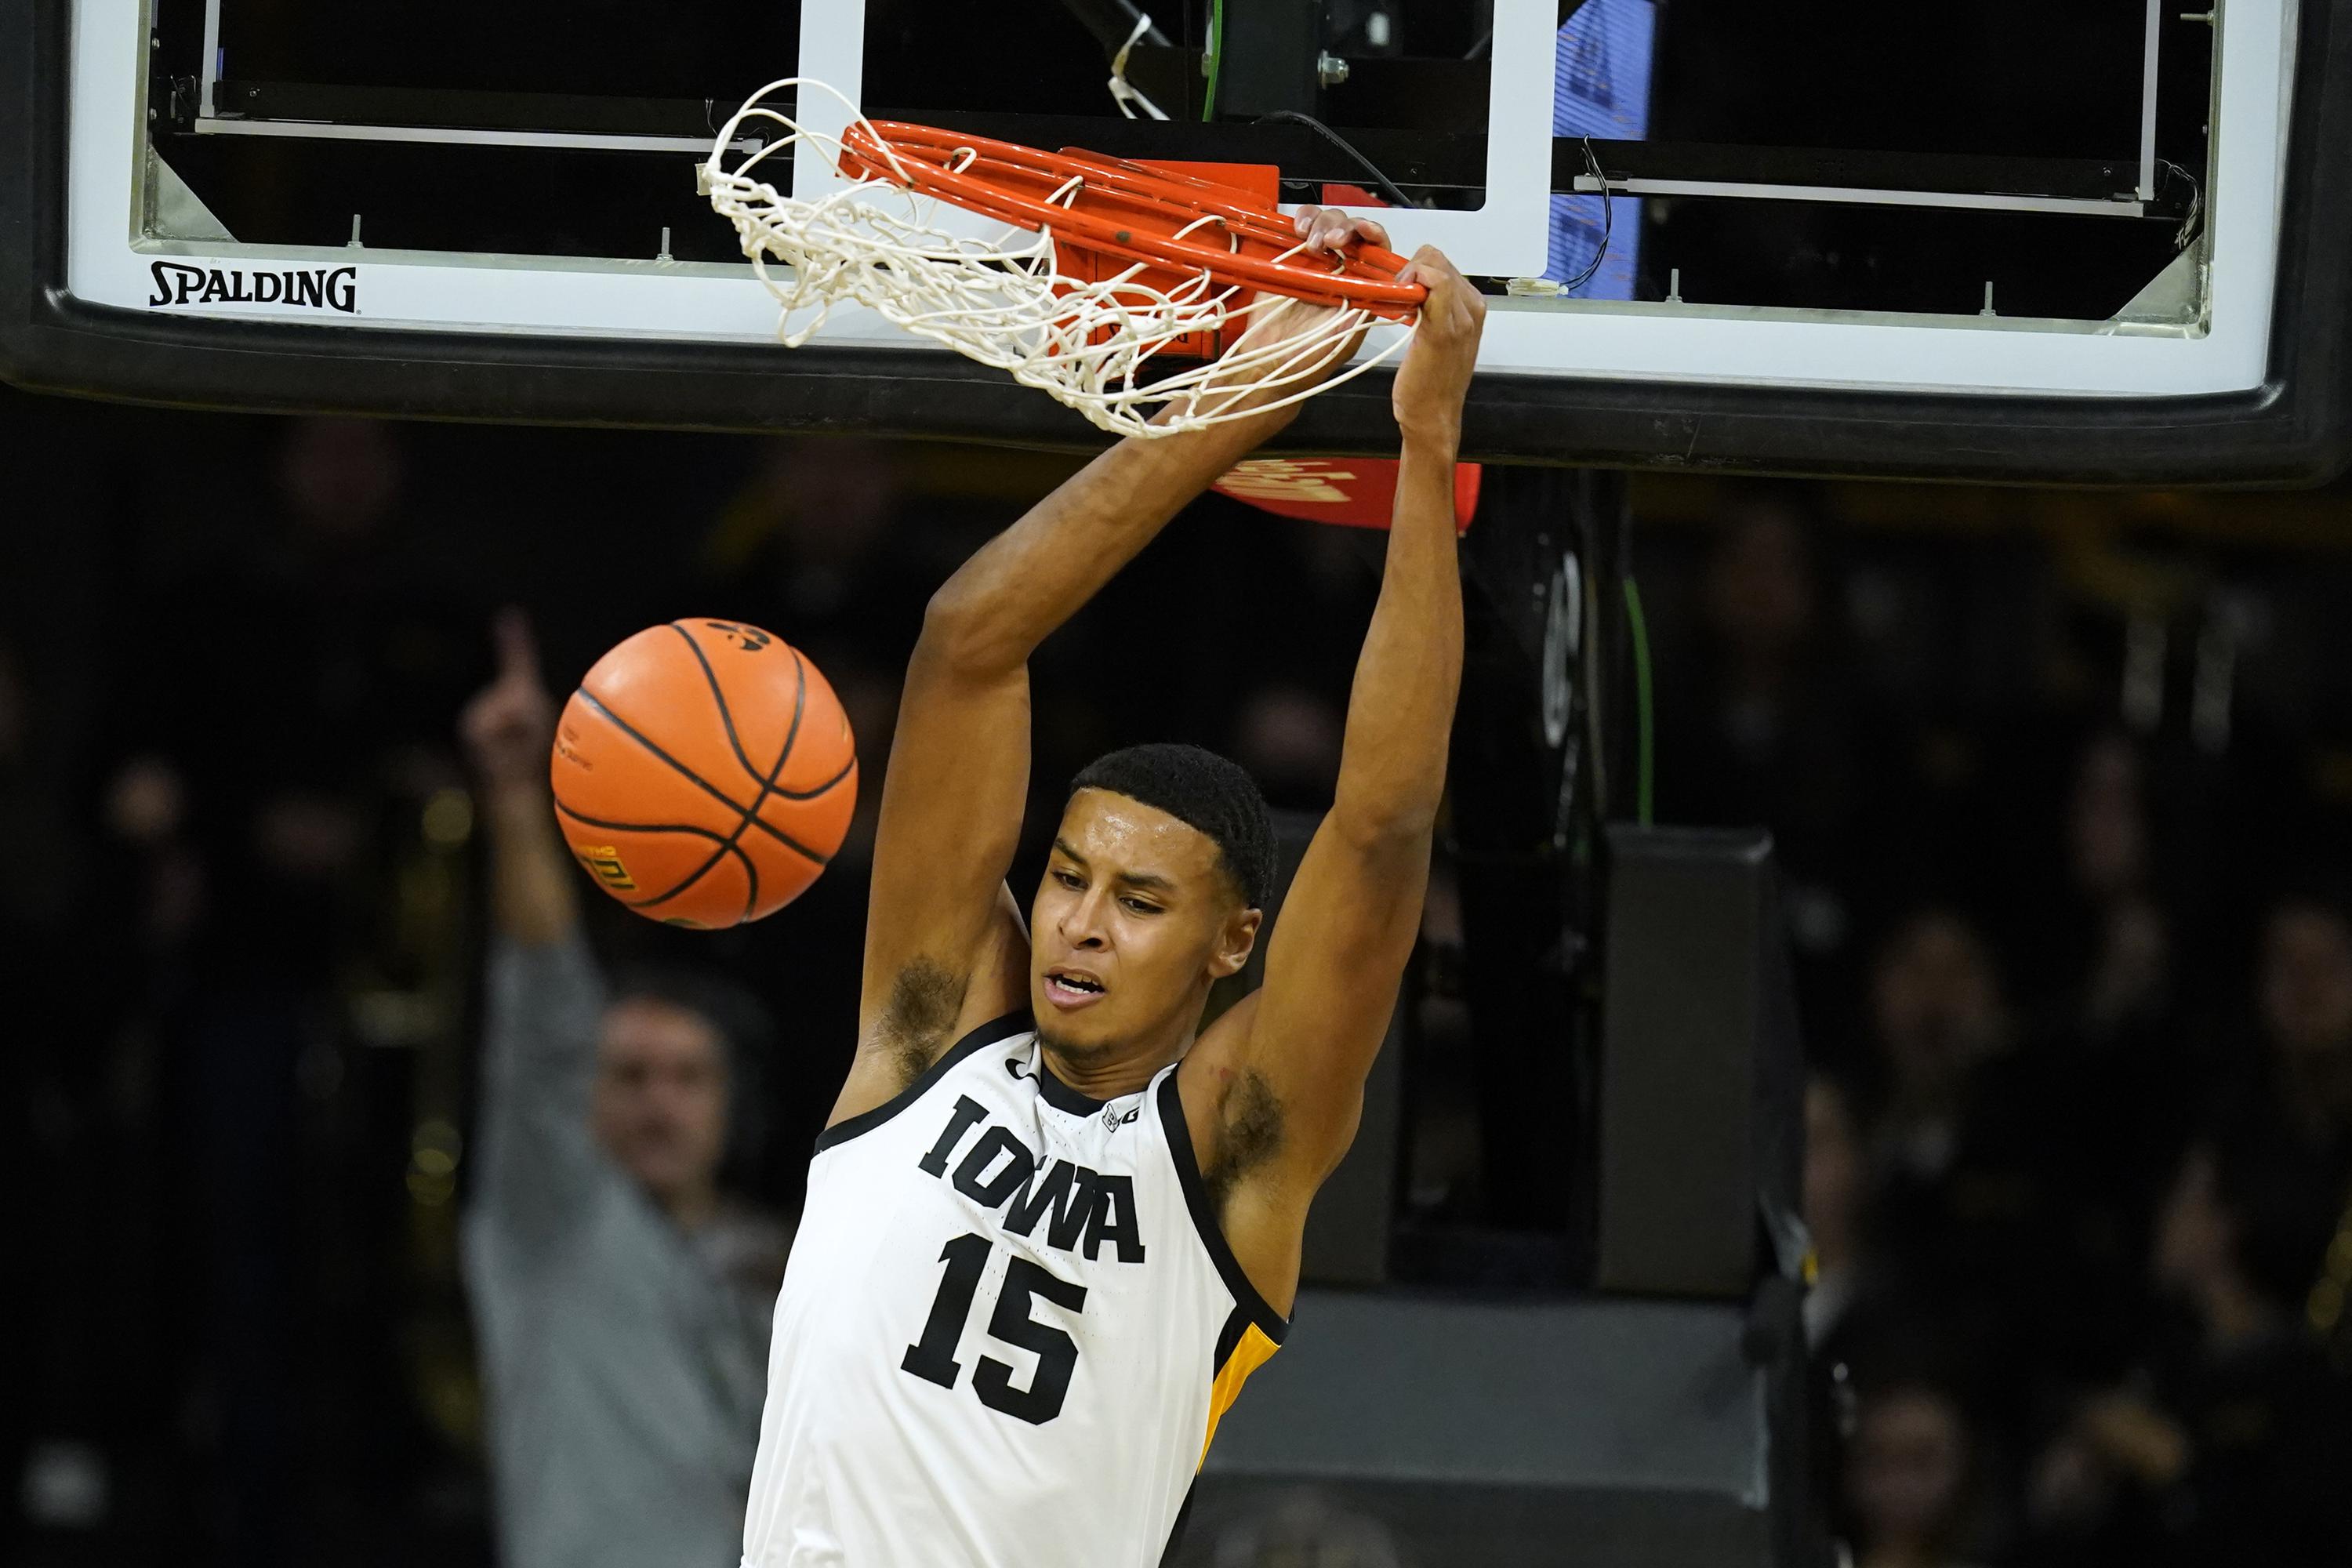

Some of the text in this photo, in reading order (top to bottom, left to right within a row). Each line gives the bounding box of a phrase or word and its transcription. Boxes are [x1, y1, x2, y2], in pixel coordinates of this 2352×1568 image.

[149, 260, 356, 314] SPALDING
[917, 1094, 1145, 1264] IOWA
[900, 1232, 1088, 1426] 15
